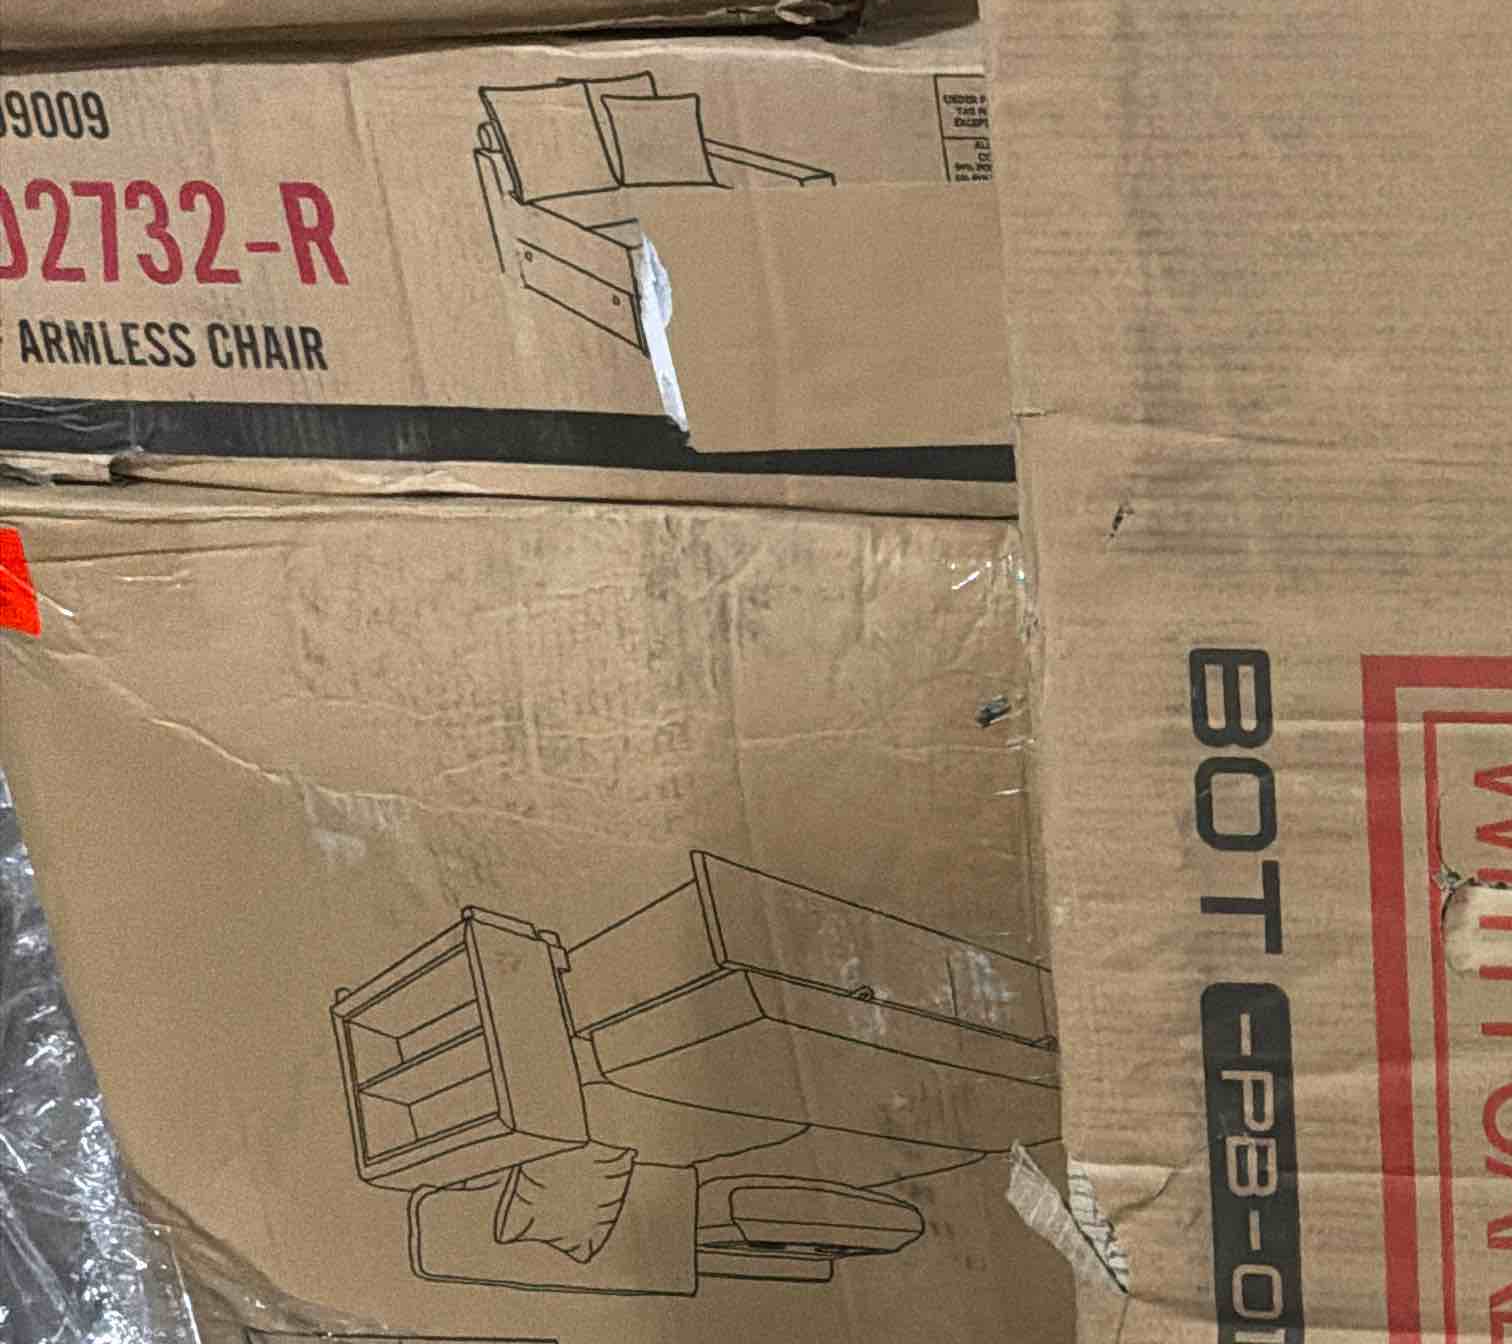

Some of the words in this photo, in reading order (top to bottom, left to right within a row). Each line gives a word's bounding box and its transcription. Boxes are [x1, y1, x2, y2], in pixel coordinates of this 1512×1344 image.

[0, 90, 110, 140] 9009
[18, 319, 197, 368] ARMLESS
[207, 322, 329, 372] CHAIR
